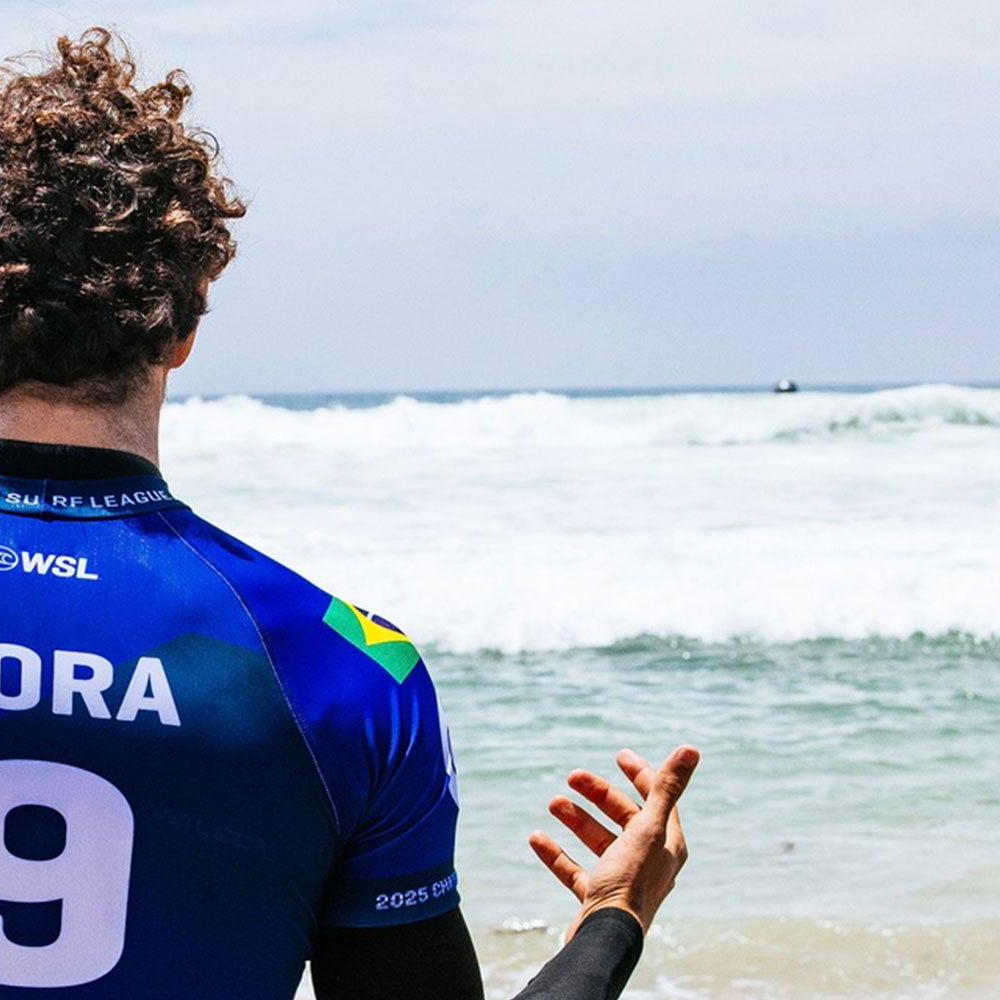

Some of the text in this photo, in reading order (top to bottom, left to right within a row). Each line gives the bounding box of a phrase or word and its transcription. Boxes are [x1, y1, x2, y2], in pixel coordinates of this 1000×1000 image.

[90, 488, 172, 508] LEAGUE
[21, 550, 99, 580] WSL
[375, 886, 429, 910] 2025
